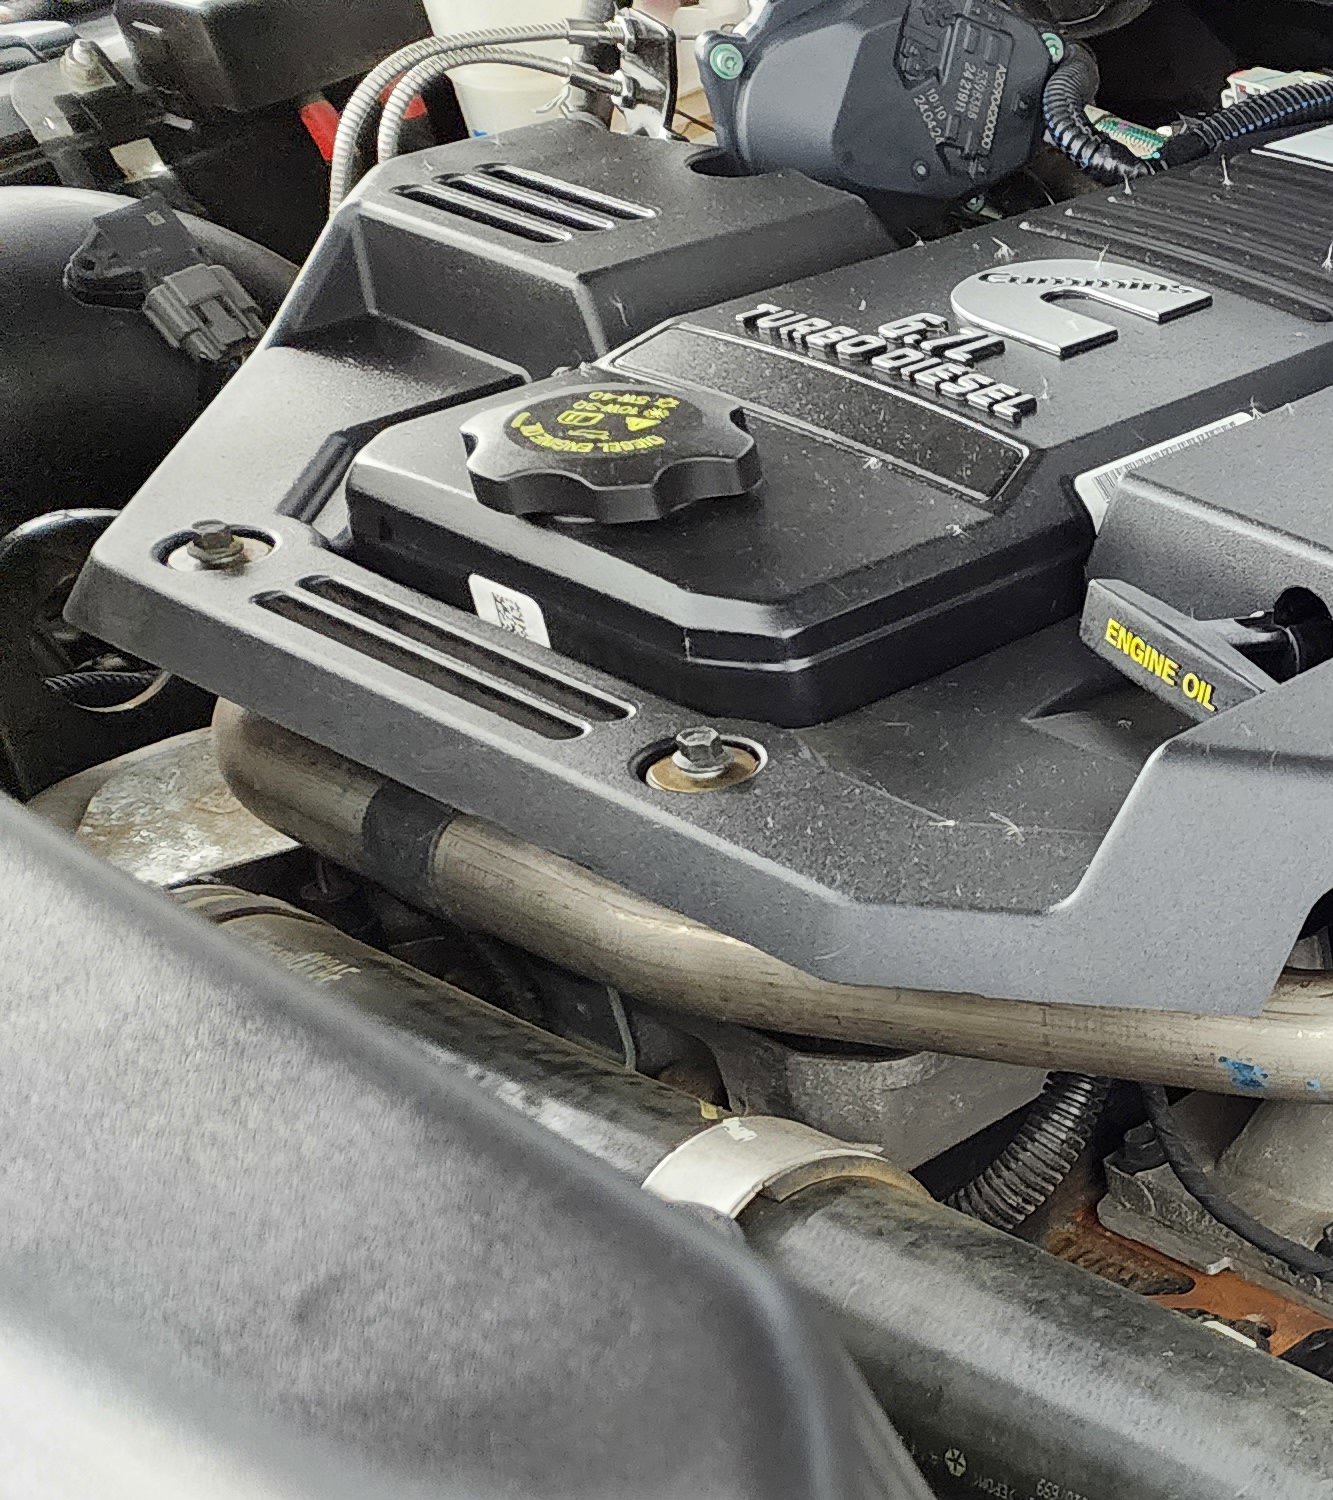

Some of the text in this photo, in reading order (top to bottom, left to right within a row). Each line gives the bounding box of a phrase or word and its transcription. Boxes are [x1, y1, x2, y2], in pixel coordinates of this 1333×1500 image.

[736, 304, 1037, 423] TURBO DIESEL
[878, 313, 1005, 367] 6.7L
[1104, 618, 1217, 712] ENGINE OIL
